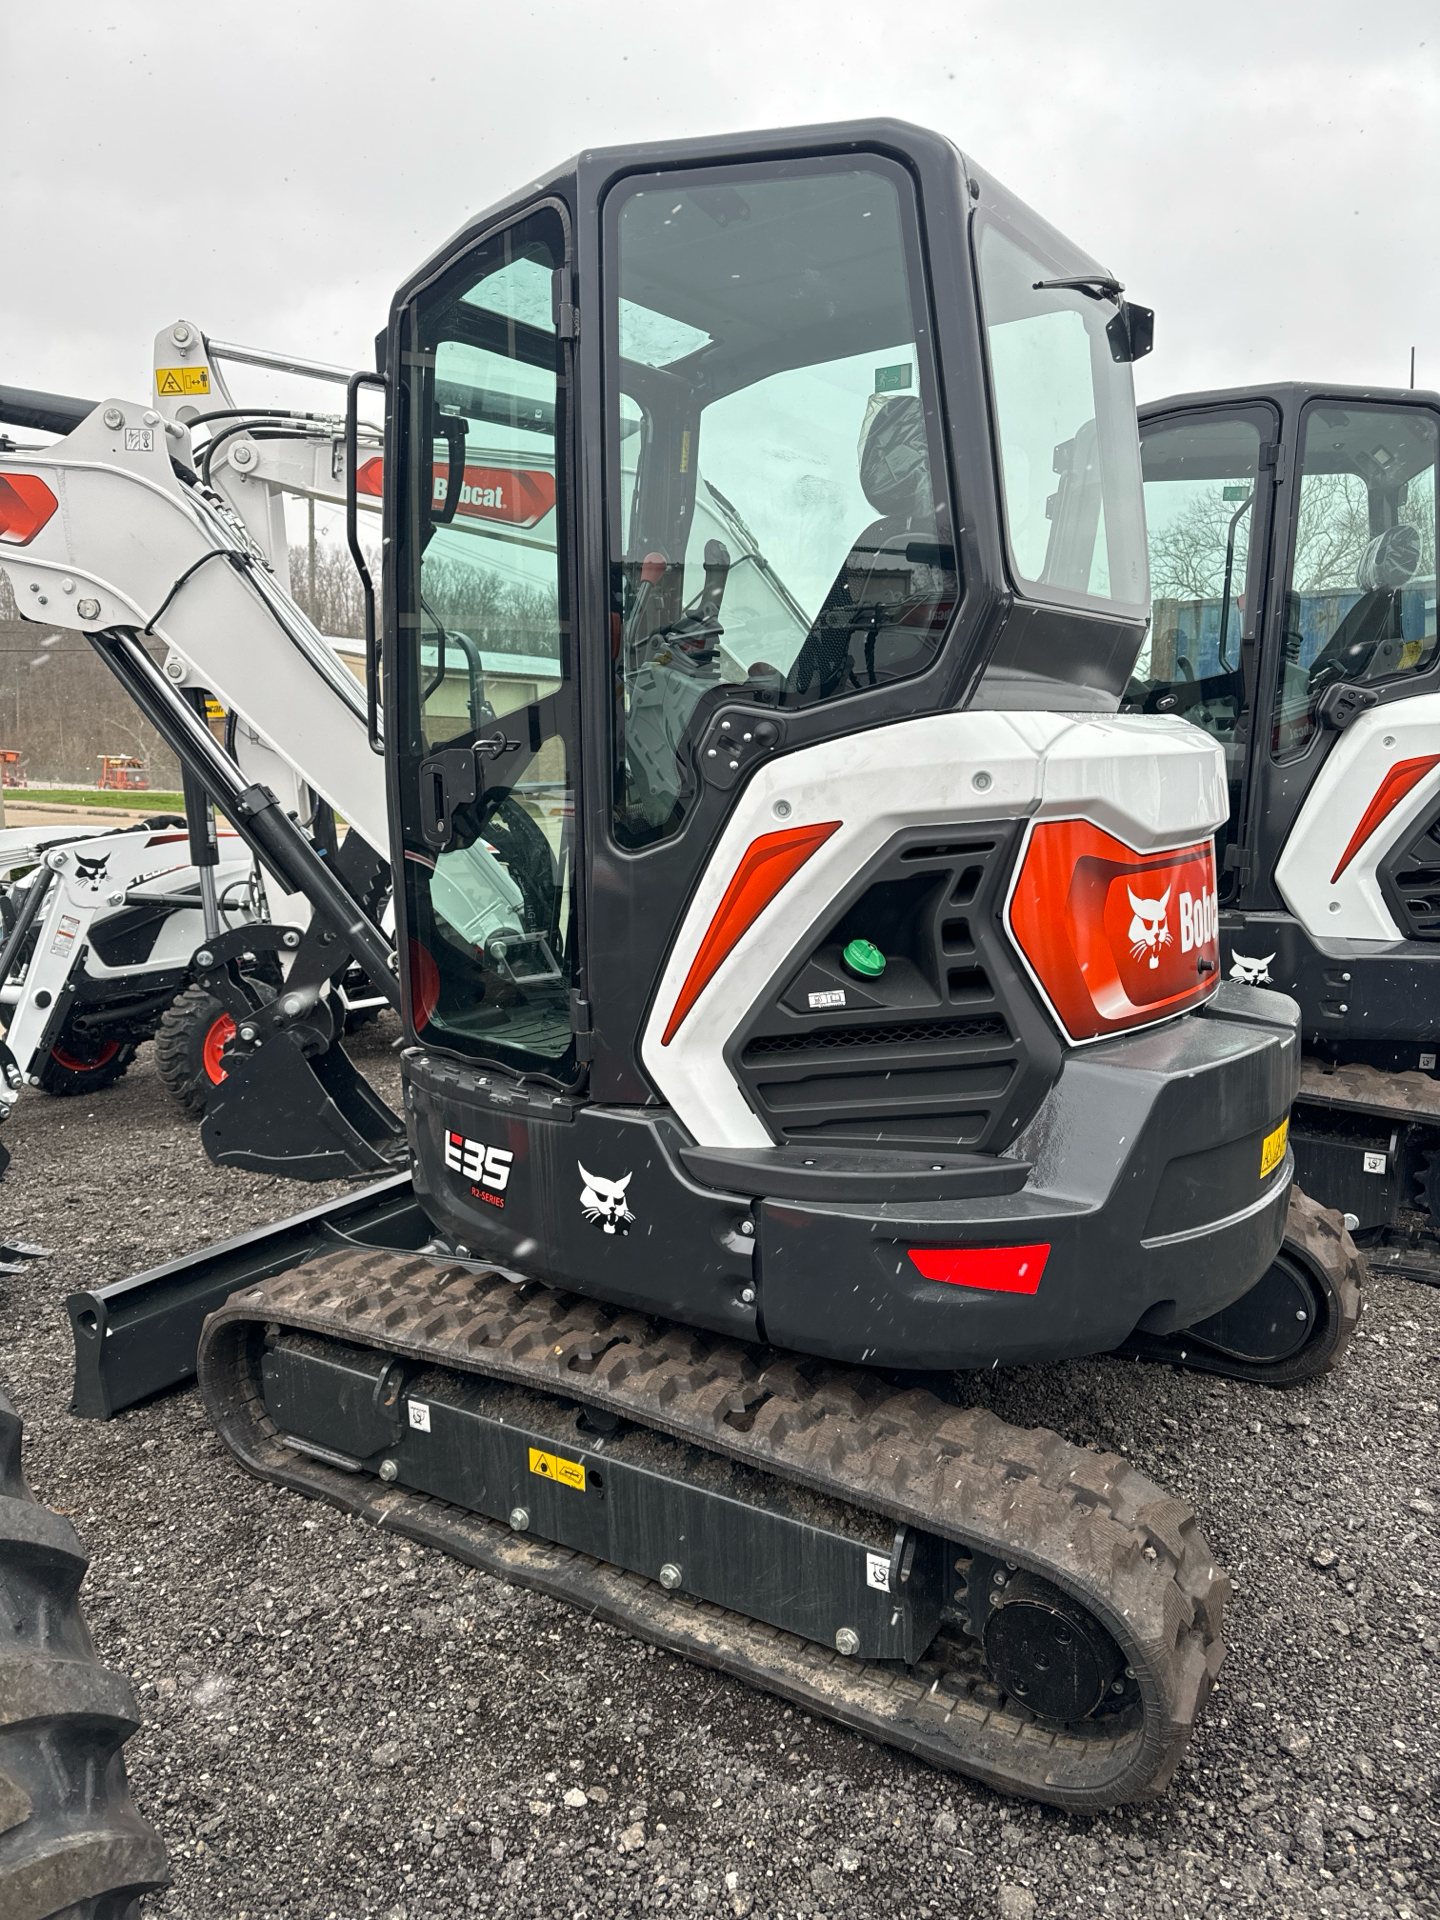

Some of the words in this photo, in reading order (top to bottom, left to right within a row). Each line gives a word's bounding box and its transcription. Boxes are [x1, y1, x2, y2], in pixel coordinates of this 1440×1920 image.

[433, 477, 503, 508] Bbcat
[444, 1129, 514, 1191] E35
[471, 1186, 505, 1209] R2-SERIES
